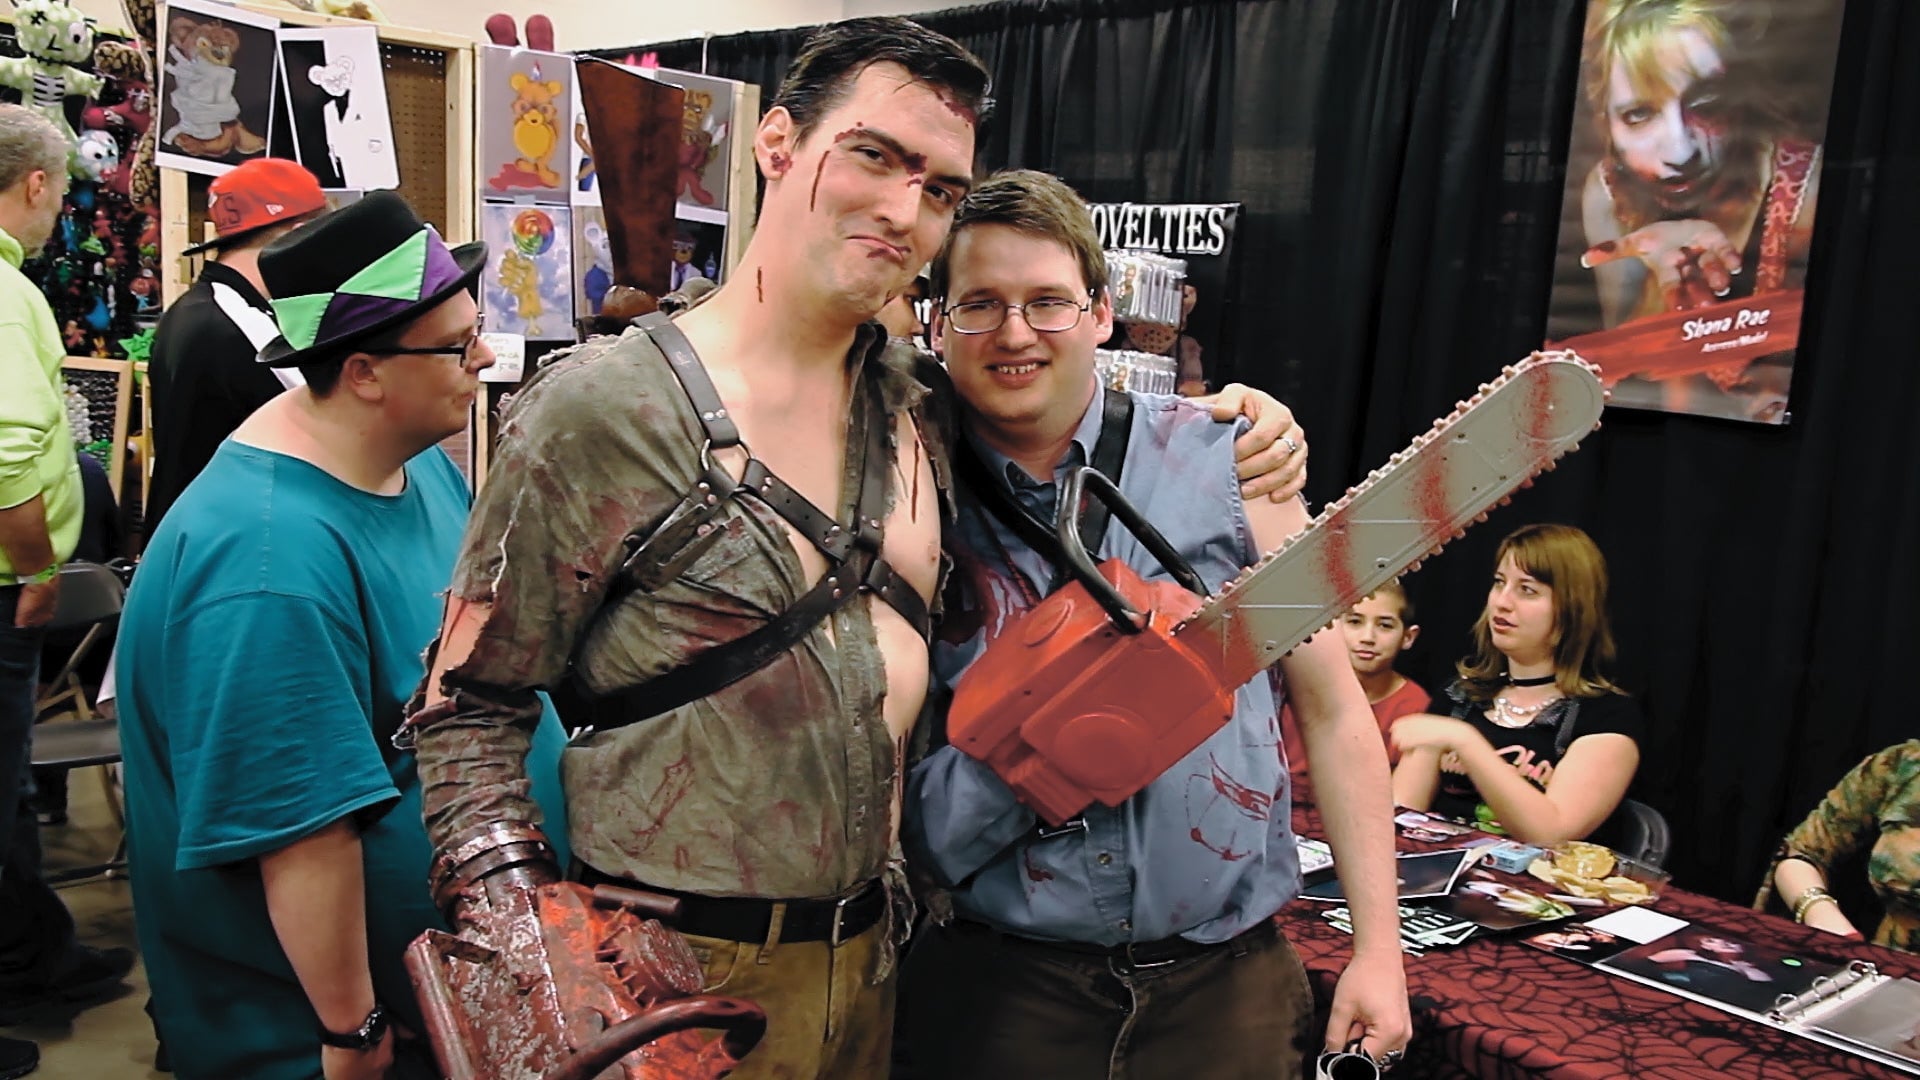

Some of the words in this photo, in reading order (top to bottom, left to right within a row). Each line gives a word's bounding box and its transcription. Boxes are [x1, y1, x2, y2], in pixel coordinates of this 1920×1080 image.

[1086, 204, 1226, 256] OVELTIES
[1682, 317, 1733, 341] Shana
[1734, 308, 1771, 330] Rae
